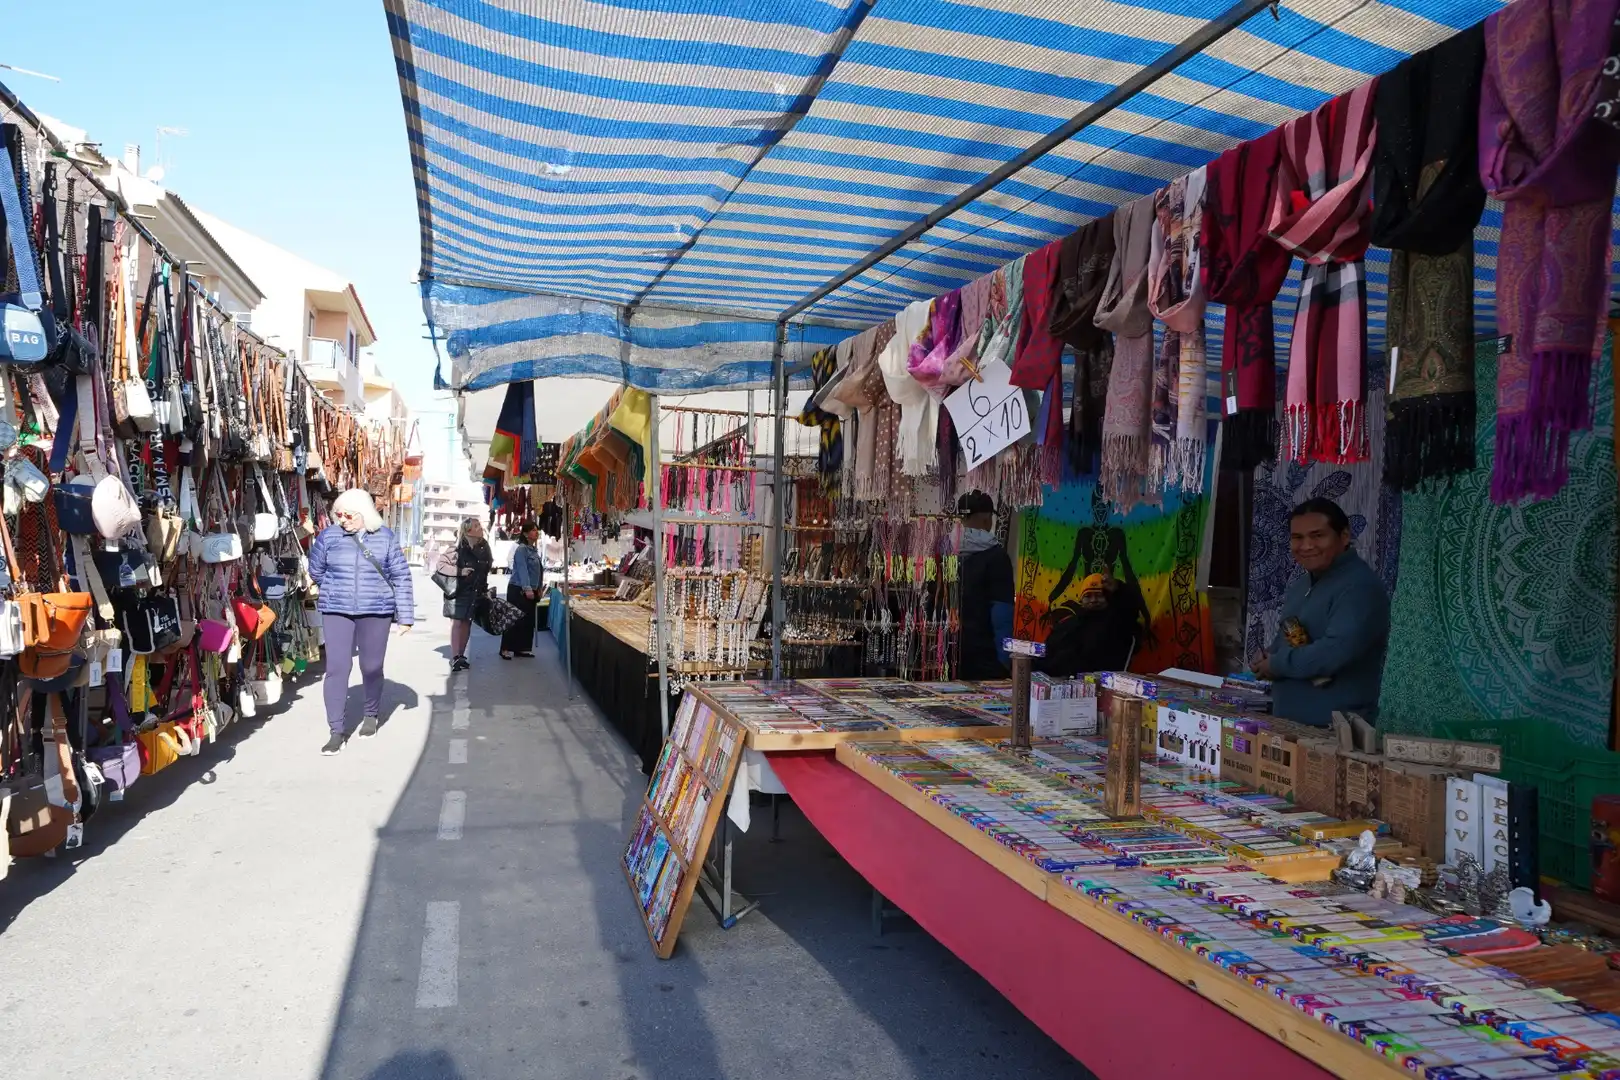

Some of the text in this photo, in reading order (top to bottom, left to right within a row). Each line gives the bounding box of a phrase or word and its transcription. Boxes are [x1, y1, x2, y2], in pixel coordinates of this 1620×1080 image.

[11, 331, 40, 346] BAG
[968, 375, 992, 419] 6
[1453, 788, 1470, 863] LOVE
[1492, 796, 1509, 876] PEACE
